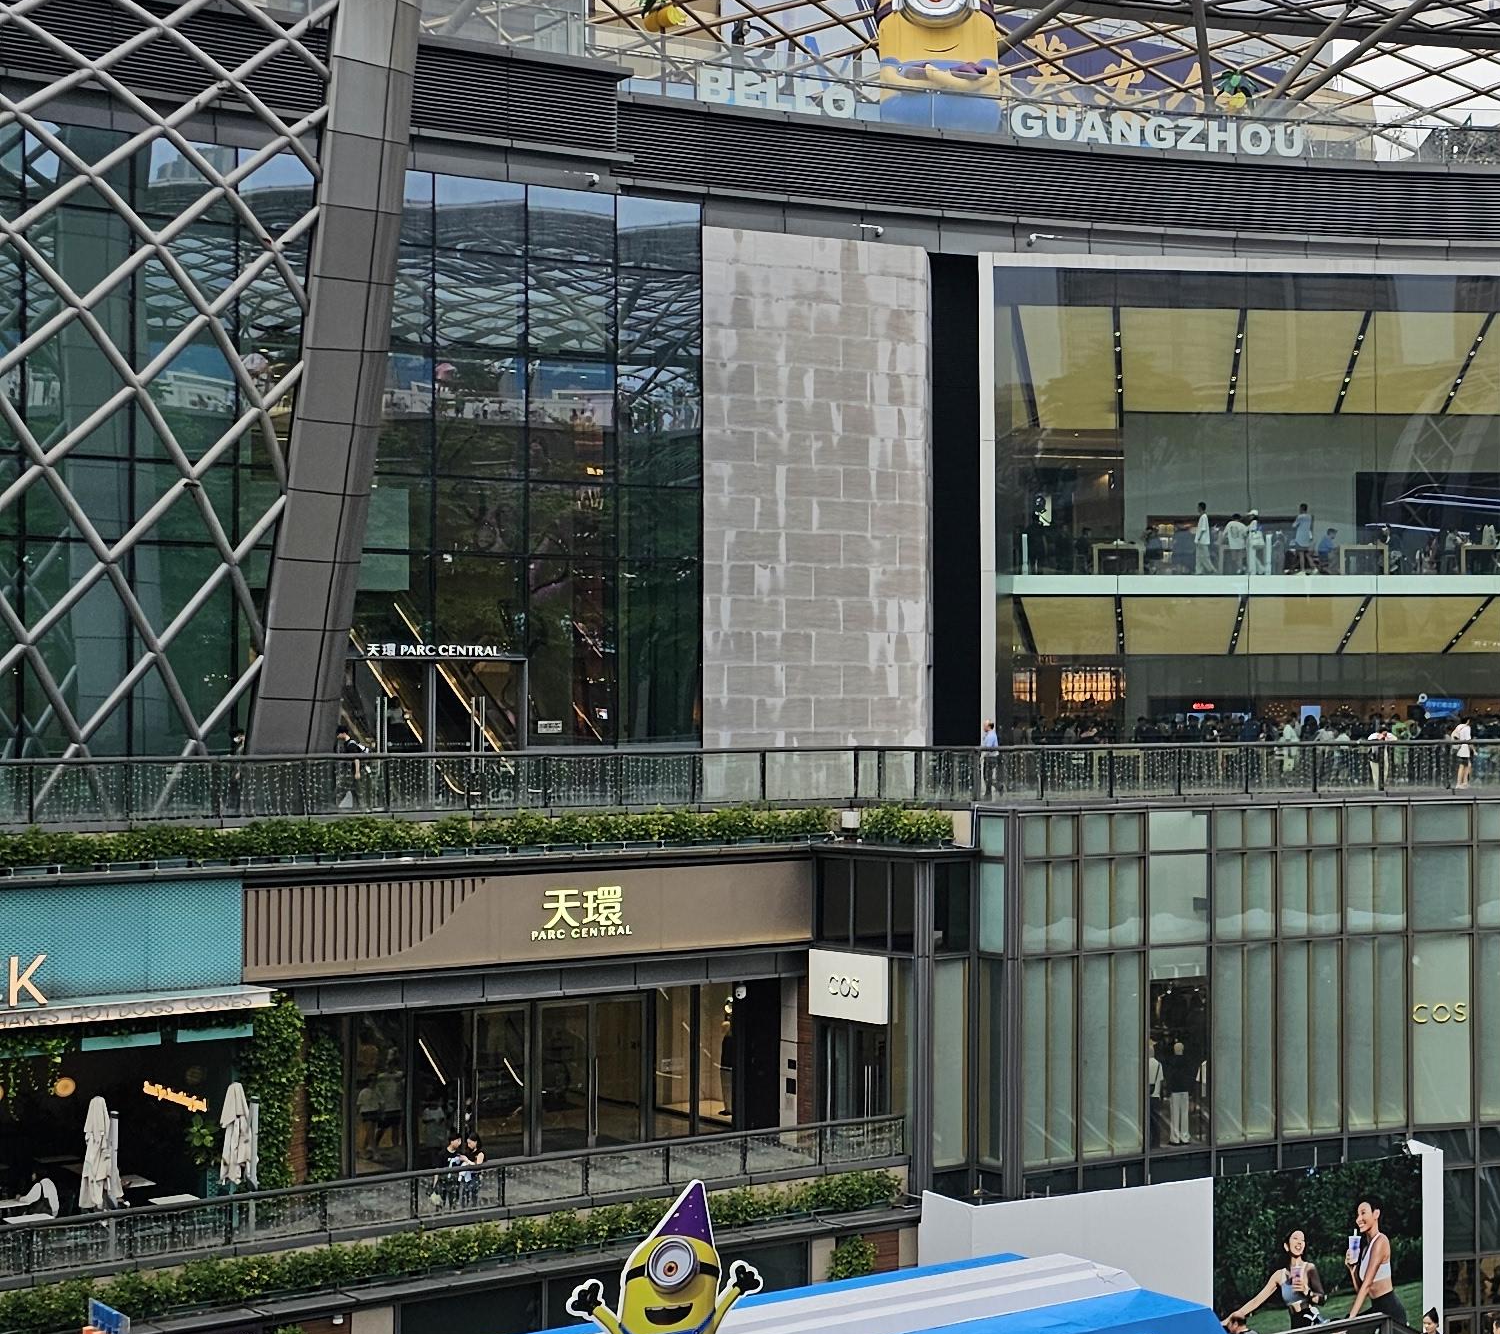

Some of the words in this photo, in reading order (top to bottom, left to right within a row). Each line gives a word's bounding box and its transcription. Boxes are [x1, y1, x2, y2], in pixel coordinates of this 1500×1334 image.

[698, 69, 857, 119] BELLO
[1010, 104, 1305, 157] GUANGZHOU
[400, 644, 436, 657] PARC
[438, 644, 500, 657] CENTRAL
[543, 885, 623, 929] 天環
[531, 928, 566, 942] PARC
[571, 924, 633, 940] CENTRAL
[828, 974, 861, 999] COS
[1412, 1002, 1468, 1025] COS
